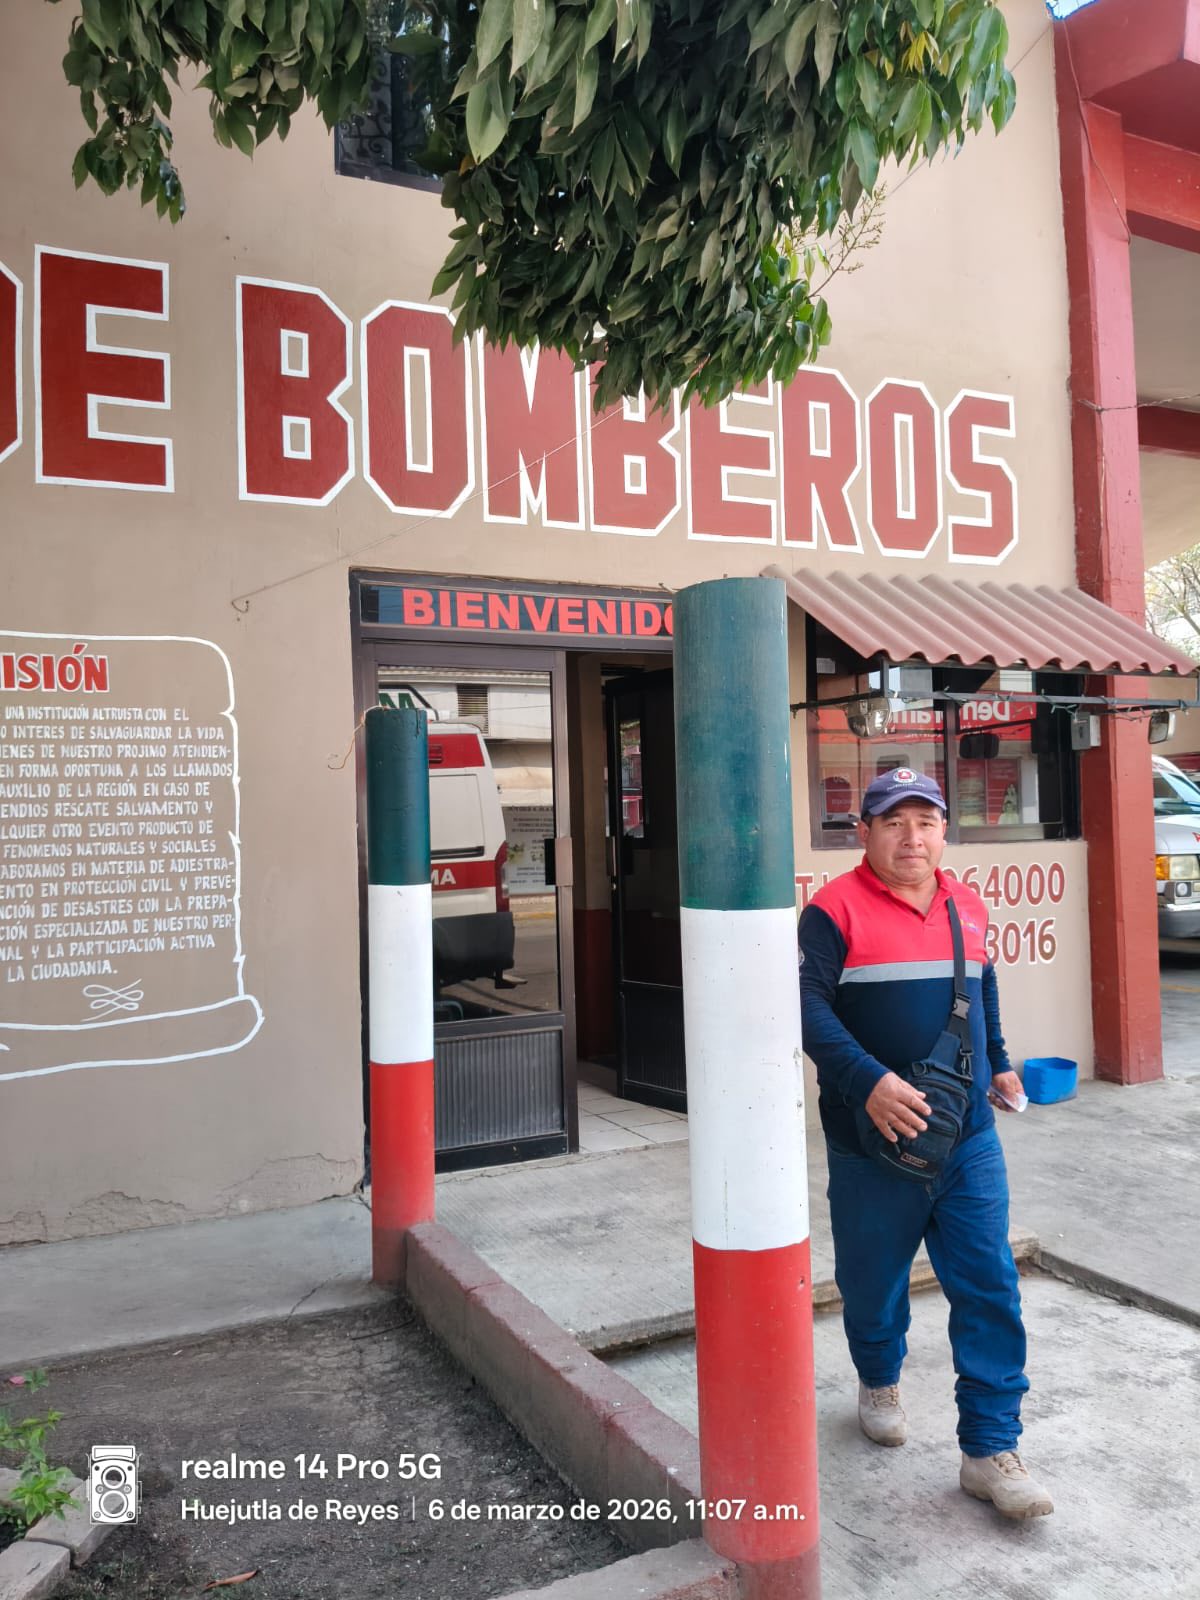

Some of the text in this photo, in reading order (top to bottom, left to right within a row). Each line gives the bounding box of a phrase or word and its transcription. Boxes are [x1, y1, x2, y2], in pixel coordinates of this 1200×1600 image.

[0, 245, 1019, 565] E BOMBEROS
[5, 705, 24, 720] UNA
[174, 708, 189, 721] EL
[13, 725, 65, 739] INTERES
[71, 726, 85, 739] DE
[90, 726, 172, 740] SALVAGUARDAR
[178, 727, 192, 740] LA
[196, 727, 224, 740] VIDA
[41, 744, 55, 758] DE
[61, 744, 113, 758] NUESTRO
[117, 744, 166, 758] PROJIMO
[172, 744, 231, 758] ATENDIEN-
[19, 763, 59, 778] FORMA
[64, 763, 123, 777] OPORTUNA
[130, 763, 139, 777] A
[146, 763, 167, 777] LOS
[173, 762, 233, 777] LLAMADOS
[0, 778, 210, 798] AUXILIO DE LA REGIÓN EN CASO DE
[0, 800, 213, 819] ENDIOS RESCATE SALVAMENTO Y
[1, 819, 214, 840] LQUIER OTRO EVENTO PRODUCTO DE
[3, 840, 217, 859] FENOMENOS NATURALES Y SOCIALES
[1, 857, 235, 880] ABORAMOS EN MATERIA DE ADIESTRA-
[40, 882, 59, 898] EN
[63, 875, 137, 896] PROTECCIÓN
[141, 877, 173, 893] CIVIL
[180, 876, 188, 892] Y
[41, 902, 58, 919] DE
[63, 898, 133, 918] DESASTRES
[138, 897, 160, 913] CON
[165, 896, 182, 913] LA
[187, 894, 233, 912] PREPA-
[34, 918, 129, 940] ESPECIALIZADA
[133, 918, 149, 934] DE
[153, 915, 209, 932] NUESTRO
[31, 944, 40, 960] Y
[47, 943, 64, 959] LA
[69, 932, 165, 957] PARTICIPACIÓN
[170, 934, 216, 951] ACTIVA
[7, 965, 25, 983] LA
